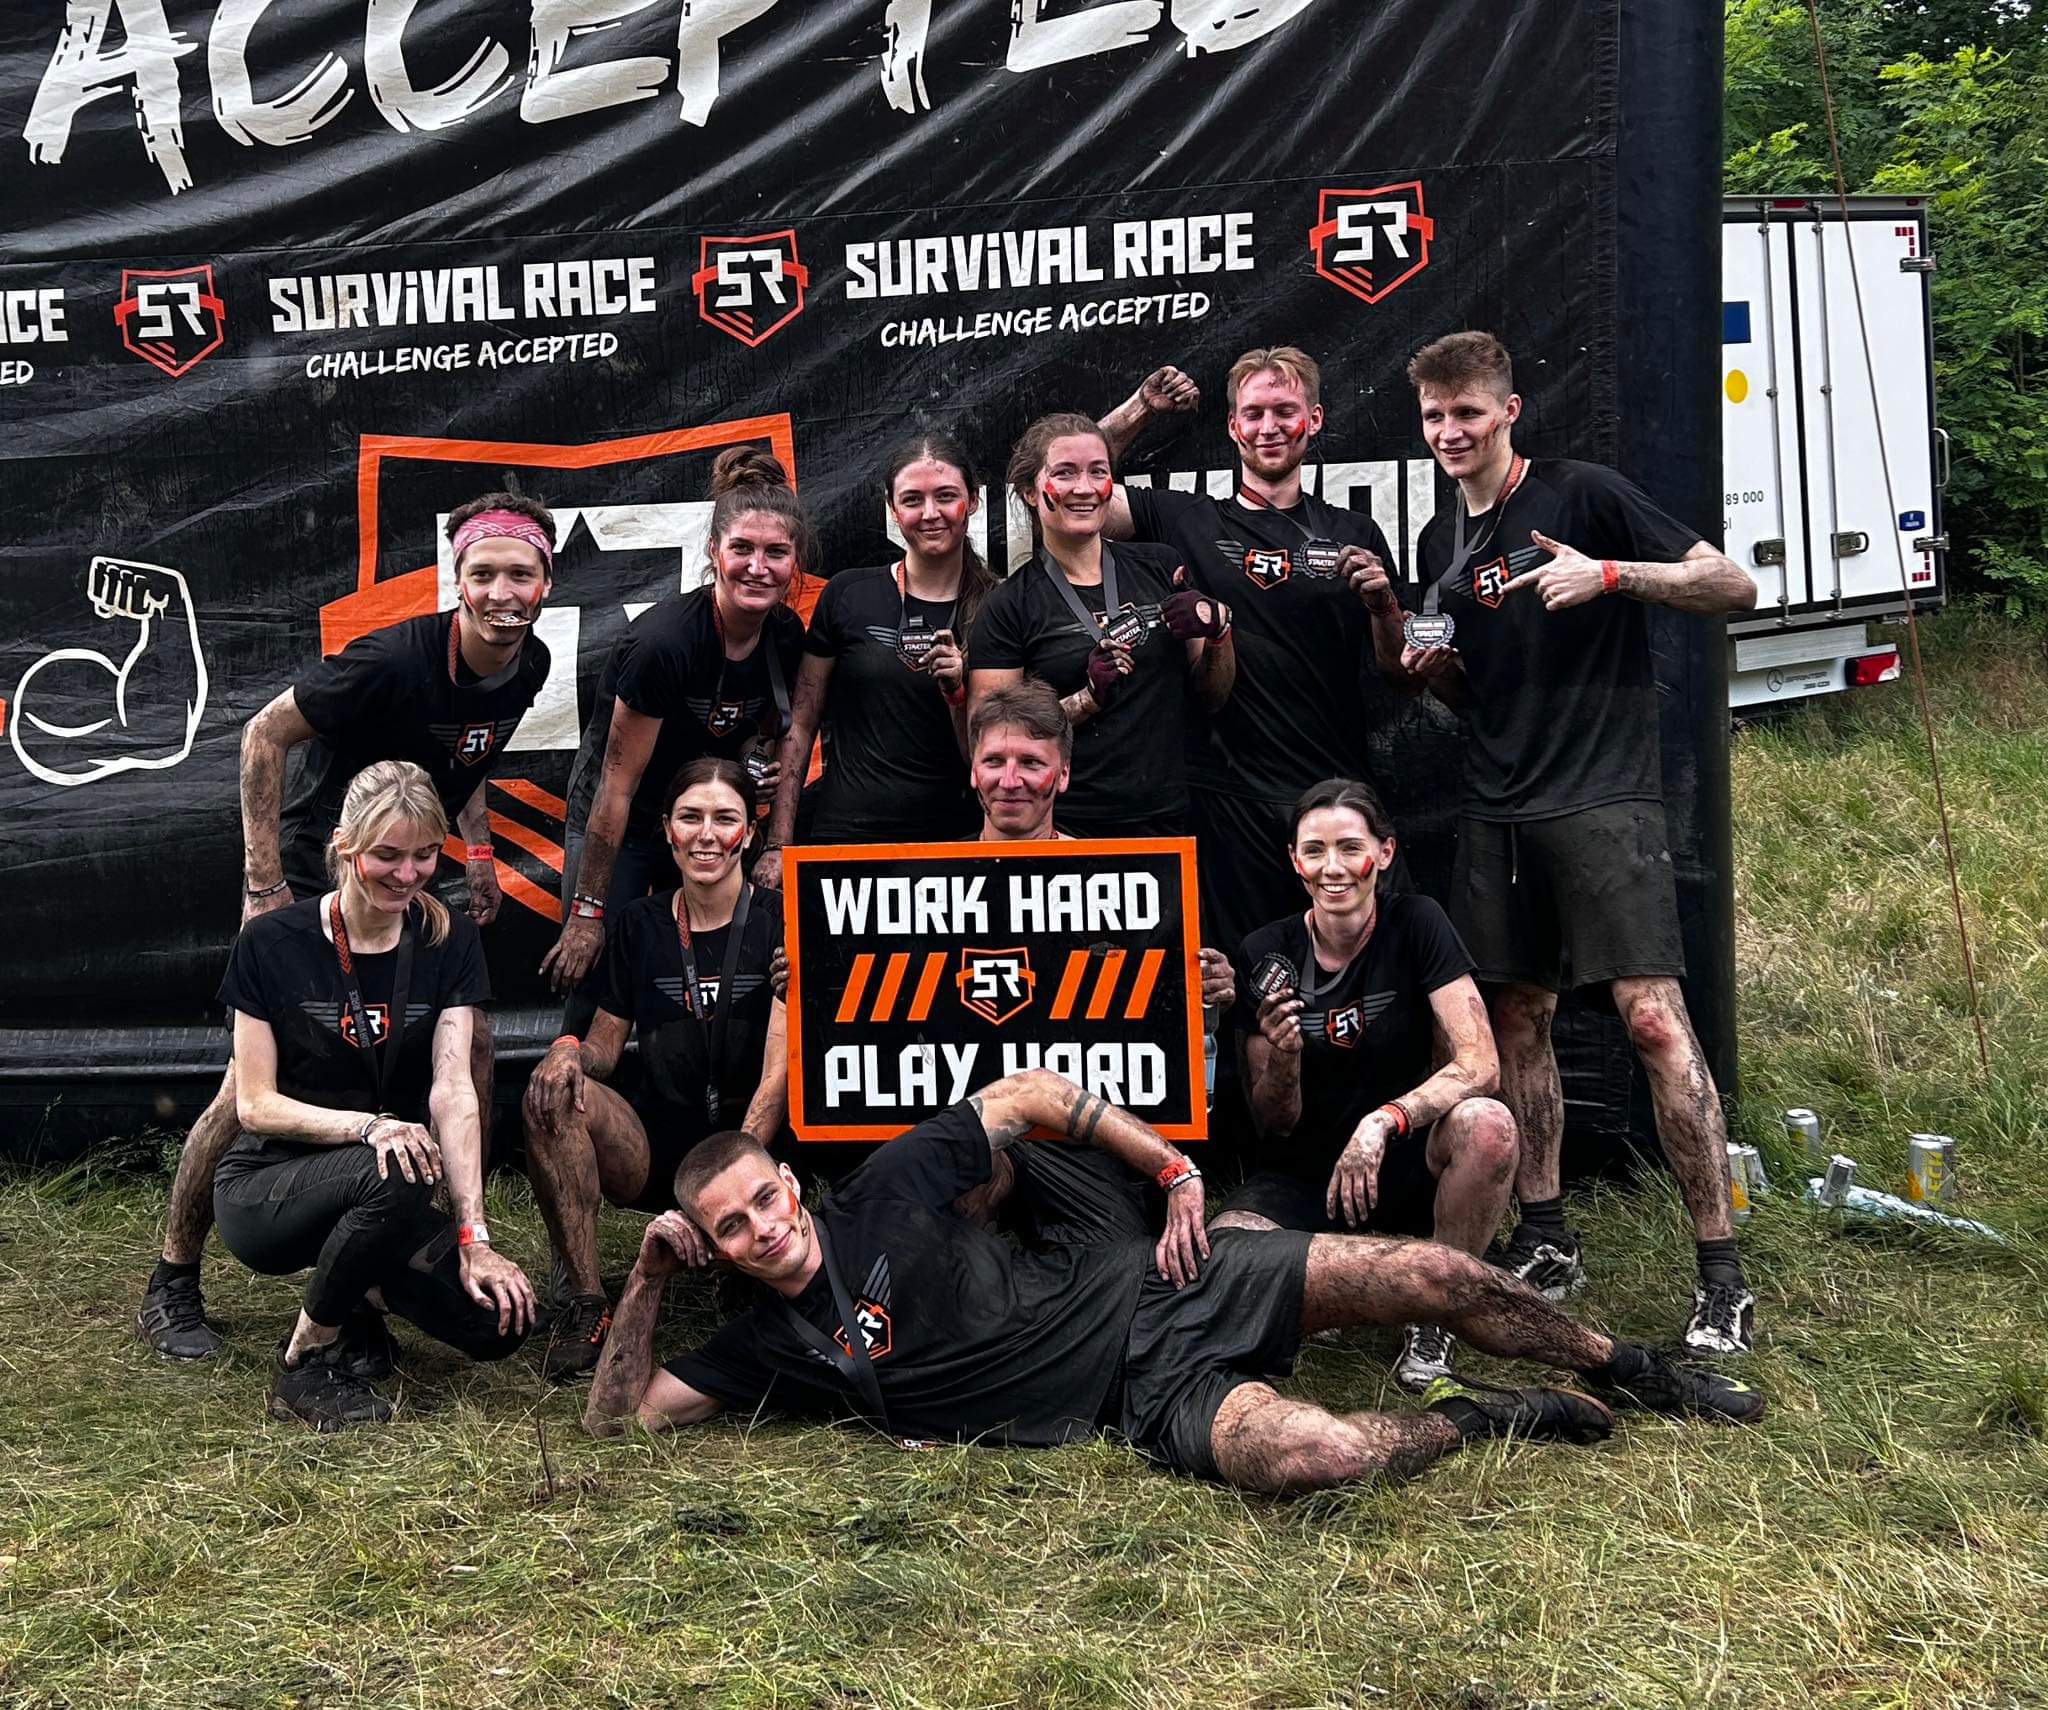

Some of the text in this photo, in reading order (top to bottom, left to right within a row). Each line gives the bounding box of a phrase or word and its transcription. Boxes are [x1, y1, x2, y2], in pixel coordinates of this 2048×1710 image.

[846, 212, 1255, 299] SURVIVAL RACE
[268, 256, 657, 334] SURVIVAL RACE
[880, 291, 1211, 348] CHALLENGE ACCEPTED
[305, 332, 619, 380] CHALLENGE ACCEPTED
[1742, 490, 1763, 503] 000
[821, 871, 1161, 935] WORK HARD
[971, 959, 1021, 998] SR
[824, 1043, 980, 1107] PLAY
